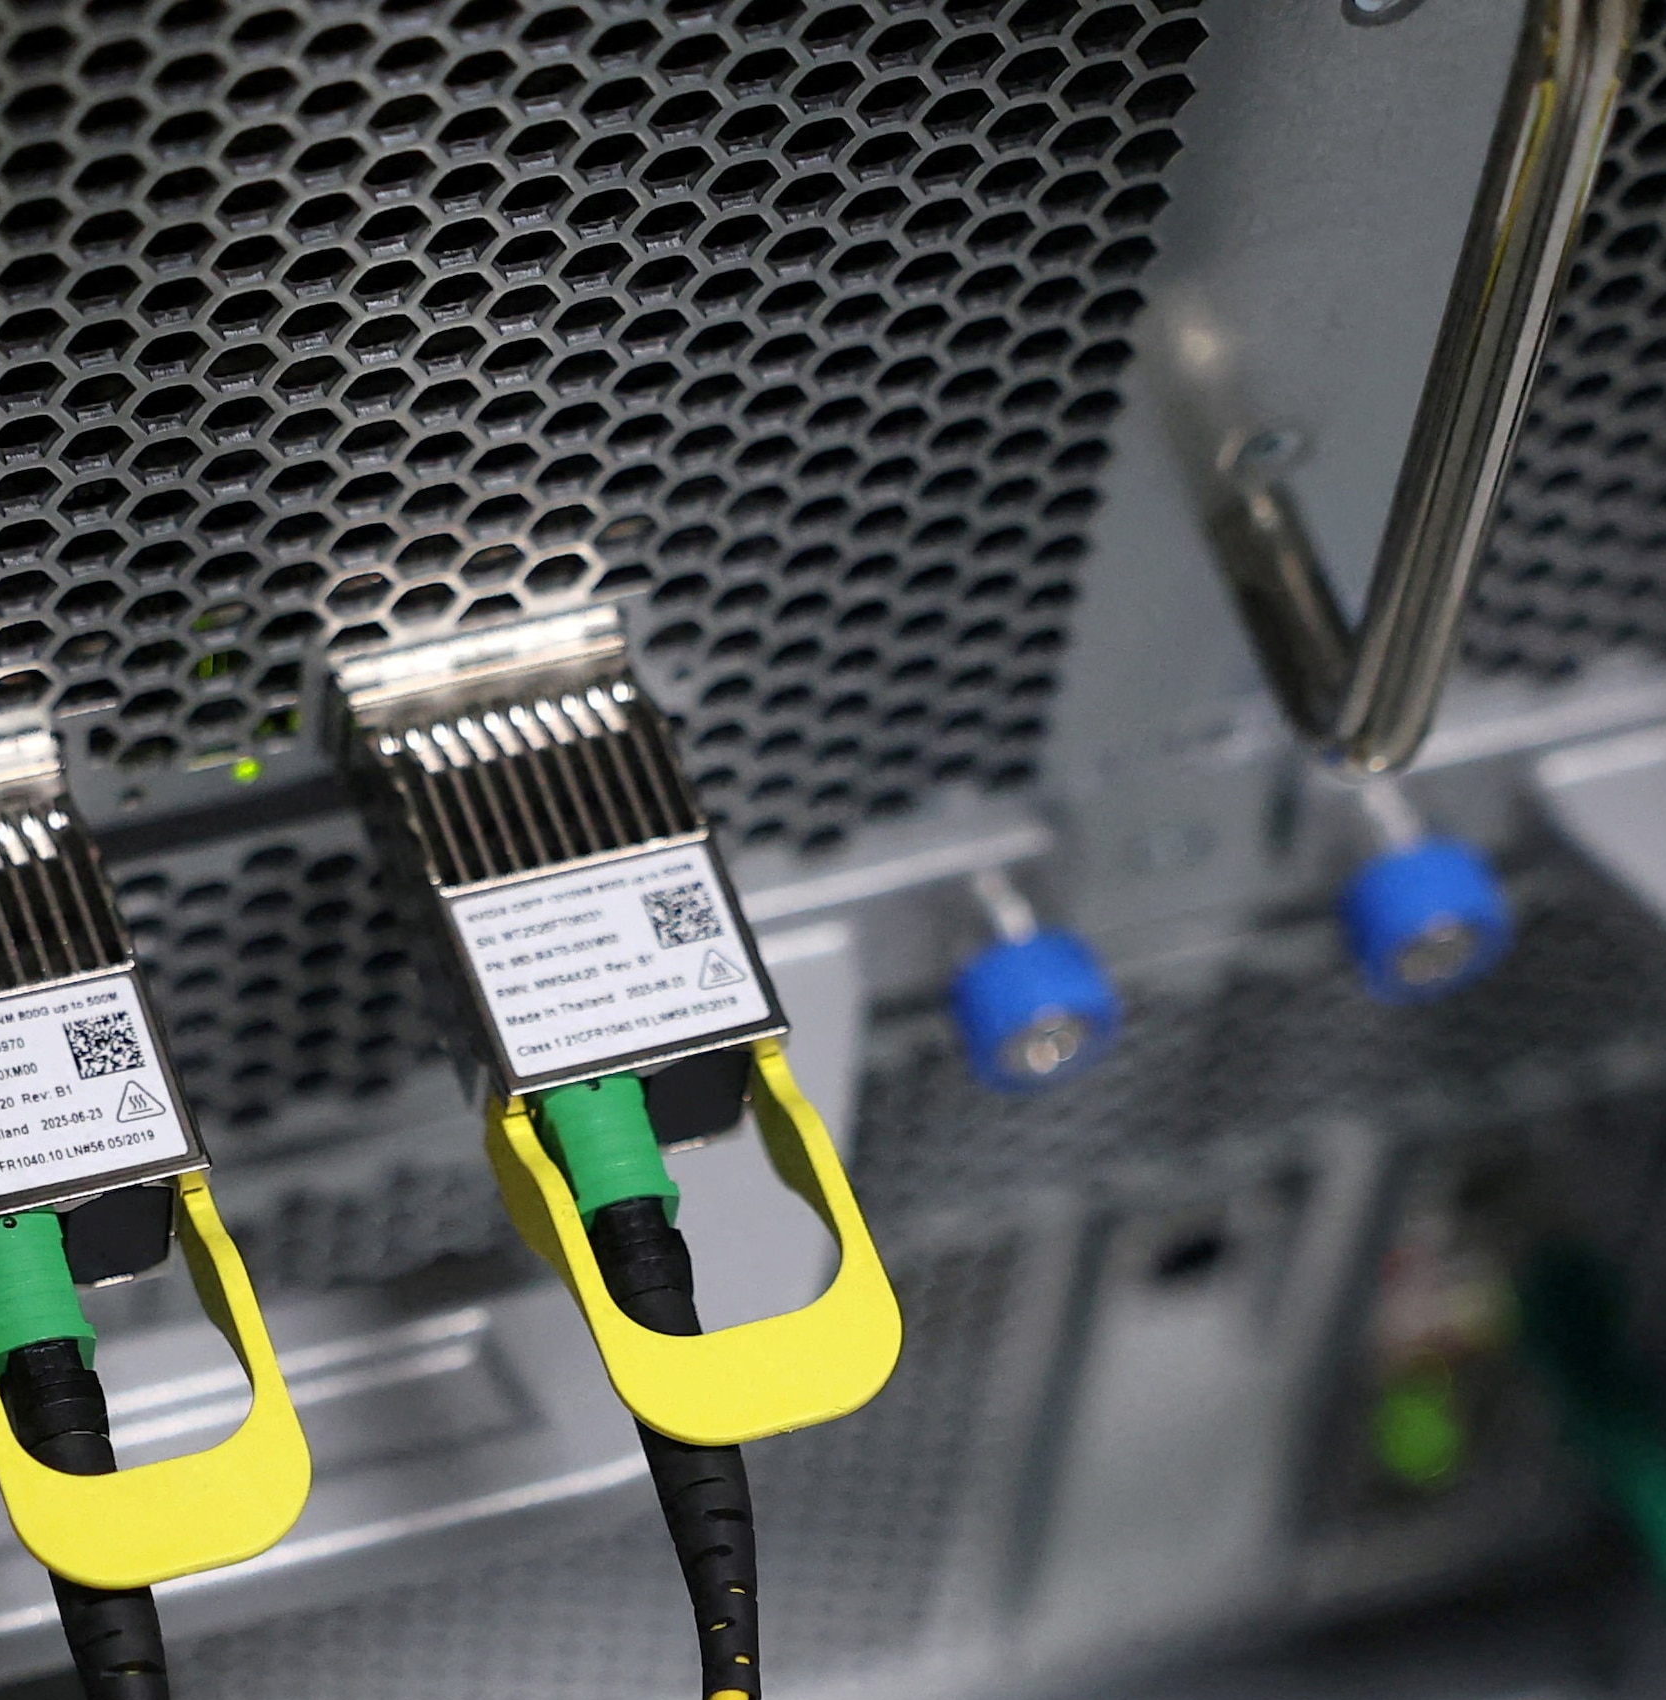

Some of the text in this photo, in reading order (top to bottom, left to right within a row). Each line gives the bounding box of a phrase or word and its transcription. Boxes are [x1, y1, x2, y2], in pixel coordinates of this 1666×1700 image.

[52, 1003, 69, 1015] up
[69, 1000, 85, 1010] to
[20, 1090, 51, 1105] Rev:
[54, 1084, 73, 1098] B1
[40, 1107, 103, 1131] 2025-06-23
[65, 1140, 106, 1159] LN#56
[107, 1129, 155, 1150] 05/2019
